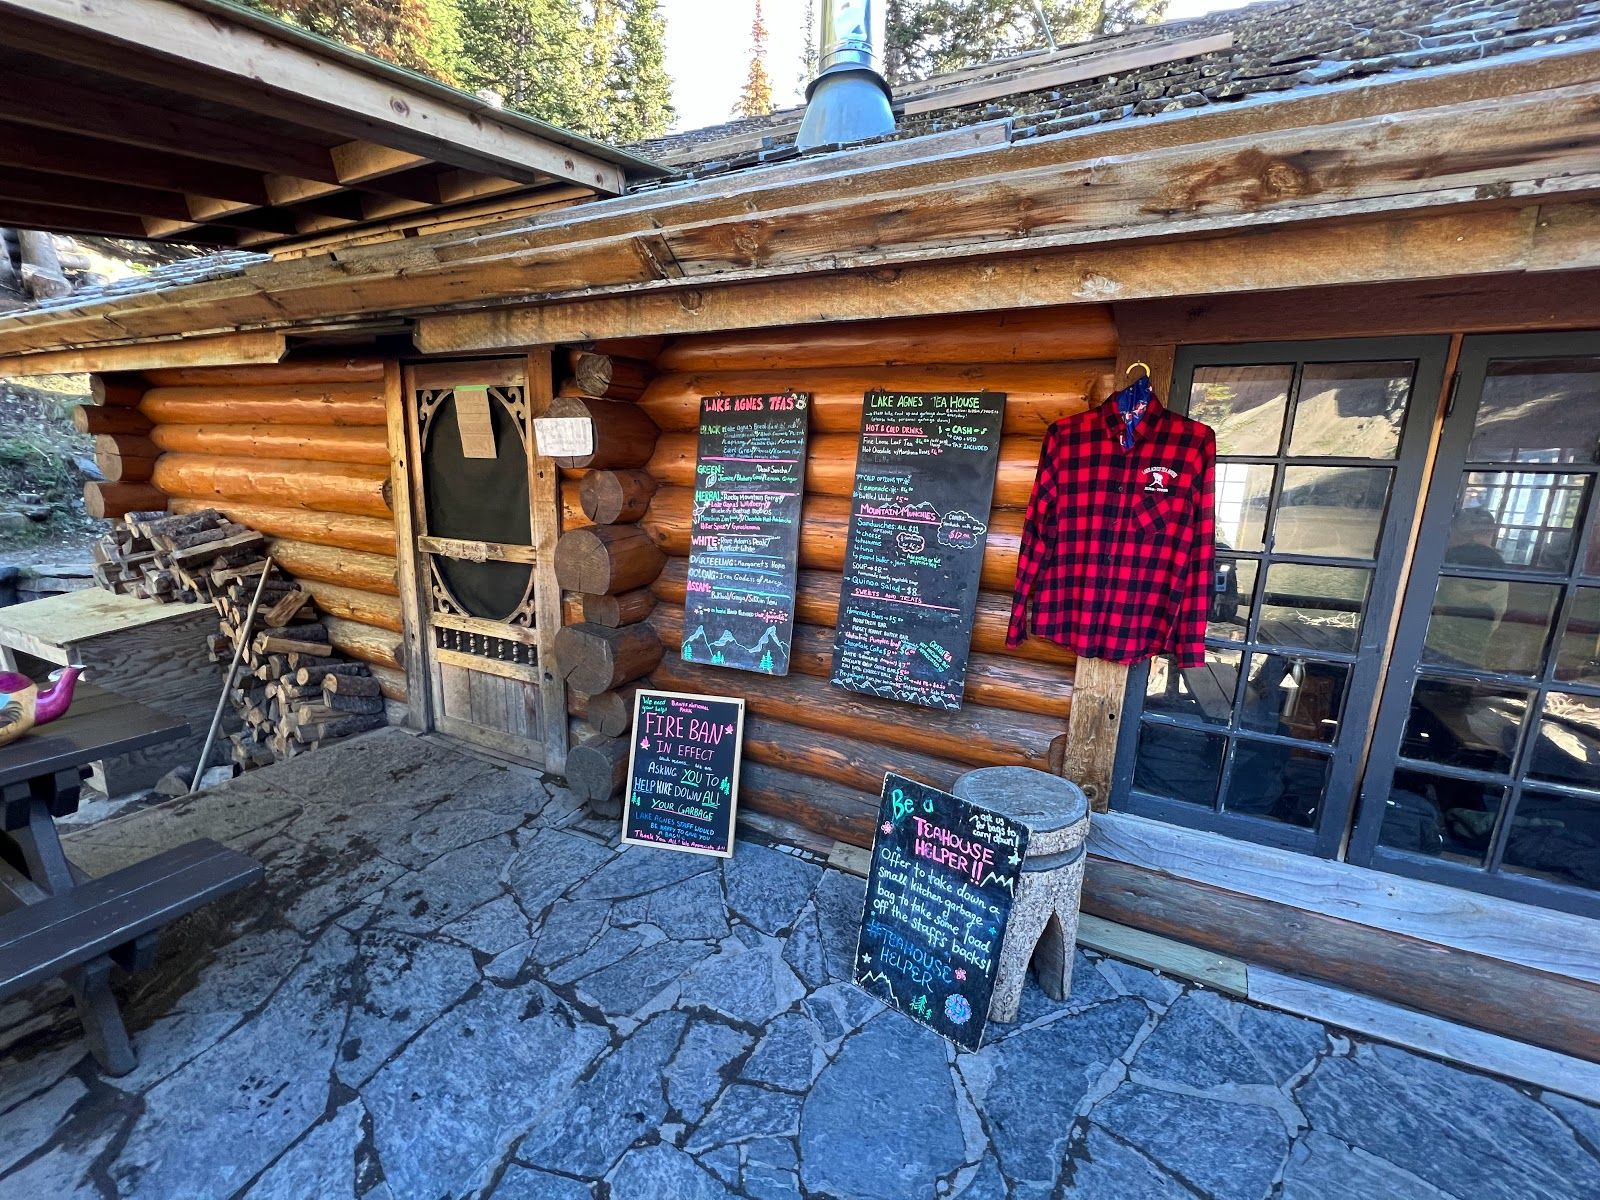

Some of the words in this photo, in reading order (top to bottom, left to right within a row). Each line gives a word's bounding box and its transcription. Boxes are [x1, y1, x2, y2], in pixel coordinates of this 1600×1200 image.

[704, 399, 731, 412] LAKE
[735, 398, 764, 411] AGNES
[769, 396, 794, 411] TEAS
[871, 395, 894, 408] LAKE
[897, 395, 923, 408] AGNES
[931, 396, 947, 408] TEA
[950, 396, 980, 408] HOUSE
[886, 425, 899, 433] COLD
[902, 426, 923, 434] DRINKS
[952, 425, 972, 434] CASH
[963, 443, 988, 451] INCLUDED
[697, 465, 724, 474] GREEN:
[858, 483, 889, 491] Lemonade
[861, 503, 899, 516] MOUNTAIN
[900, 507, 936, 521] MUNCHIES
[857, 517, 896, 530] Sandwiches:
[691, 535, 720, 546] WHITE:
[862, 531, 881, 540] cheese
[860, 545, 873, 553] tuna
[771, 560, 785, 570] Hope
[853, 562, 867, 570] SOUP
[893, 559, 906, 567] jam
[688, 568, 719, 580] OOLONG:
[719, 573, 733, 581] Iron
[756, 575, 763, 583] of
[687, 581, 711, 593] ASSAM:
[852, 576, 879, 586] Quinoa
[881, 582, 900, 592] Salad
[900, 595, 922, 603] TREATS
[642, 696, 652, 705] We
[646, 712, 684, 738] FIRE
[689, 718, 724, 746] BAN
[657, 740, 671, 753] IN
[678, 744, 715, 761] EFFECT
[648, 762, 677, 777] ASKING
[681, 769, 702, 783] YOU
[706, 773, 719, 787] TO
[634, 776, 656, 792] HELP
[656, 778, 673, 796] HIKE
[674, 786, 702, 802] DOWN
[702, 791, 721, 805] ALL
[651, 798, 675, 810] YOUR
[678, 804, 715, 821] GARBAGE
[891, 788, 915, 820] Be
[923, 798, 934, 813] a
[635, 812, 652, 820] LAKE
[654, 814, 675, 825] AGNES
[677, 821, 694, 830] STAFF
[695, 825, 715, 836] WOULD
[980, 813, 993, 822] ask
[995, 815, 1005, 826] us
[634, 830, 654, 840] Thank
[656, 834, 666, 843] You
[660, 825, 676, 834] HAPPY
[699, 833, 710, 841] YOU
[972, 829, 991, 843] carry
[976, 821, 986, 831] for
[987, 823, 1006, 838] bags
[1007, 826, 1017, 837] to
[912, 815, 995, 866] TEAHOUSE
[881, 846, 912, 869] Offer
[914, 863, 926, 877] to
[927, 869, 954, 893] take
[956, 883, 987, 910] down
[988, 905, 1000, 915] a
[878, 865, 908, 886] small
[911, 877, 944, 904] kitchen
[943, 899, 985, 927] garbage
[877, 881, 896, 905] bag
[898, 892, 909, 907] to
[911, 897, 933, 920] take
[933, 915, 960, 936] some
[963, 929, 991, 954] load
[872, 899, 890, 915] off
[891, 904, 908, 922] the
[911, 917, 949, 948] staff's
[950, 939, 992, 978] backs!
[866, 919, 954, 984] #TEAHOUSE
[880, 946, 934, 994] HELPER
